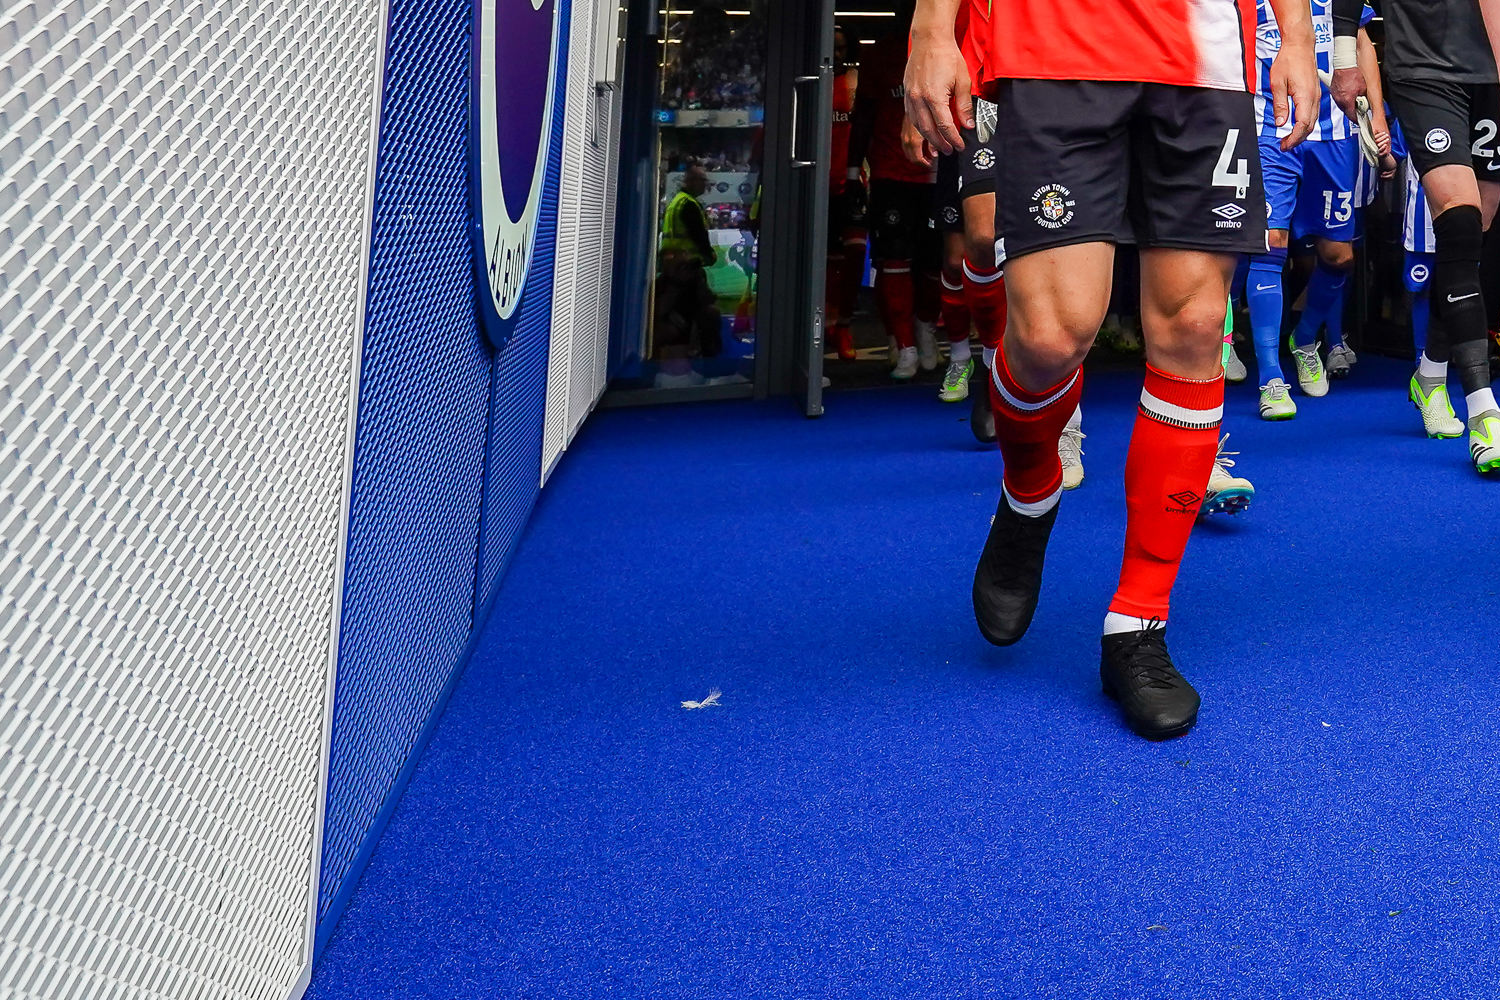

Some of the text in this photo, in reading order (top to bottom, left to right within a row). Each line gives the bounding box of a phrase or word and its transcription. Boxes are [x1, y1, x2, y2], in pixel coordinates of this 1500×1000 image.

[1212, 128, 1250, 199] 4
[1031, 183, 1071, 201] LUTON TOWN
[1322, 190, 1352, 222] 13
[1034, 210, 1074, 229] FOOTBALL CLUB
[1215, 219, 1242, 228] umbro
